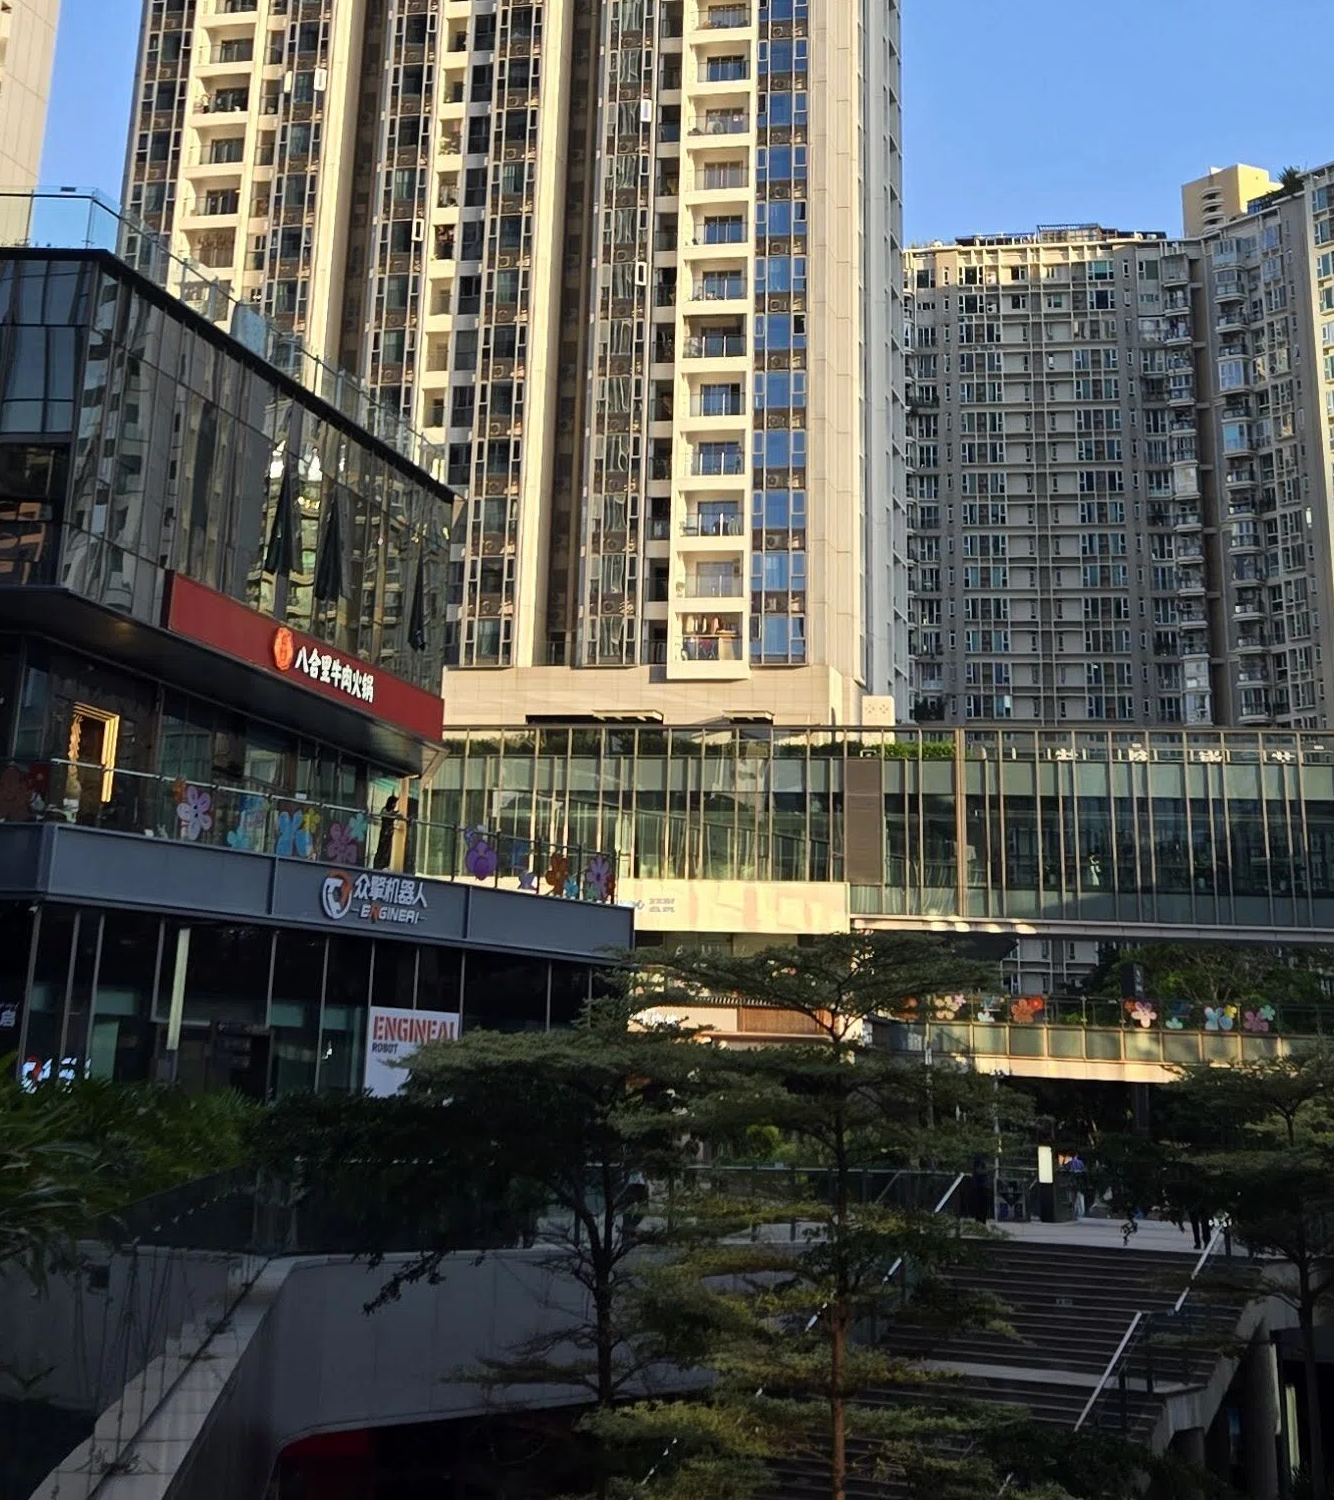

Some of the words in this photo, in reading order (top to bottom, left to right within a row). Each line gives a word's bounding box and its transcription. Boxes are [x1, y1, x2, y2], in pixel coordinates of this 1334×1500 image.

[294, 646, 374, 703] 八合里牛肉火锅
[353, 874, 427, 908] 众擎机器人
[360, 901, 420, 924] ENGINEAI
[372, 1042, 399, 1054] ROBOT
